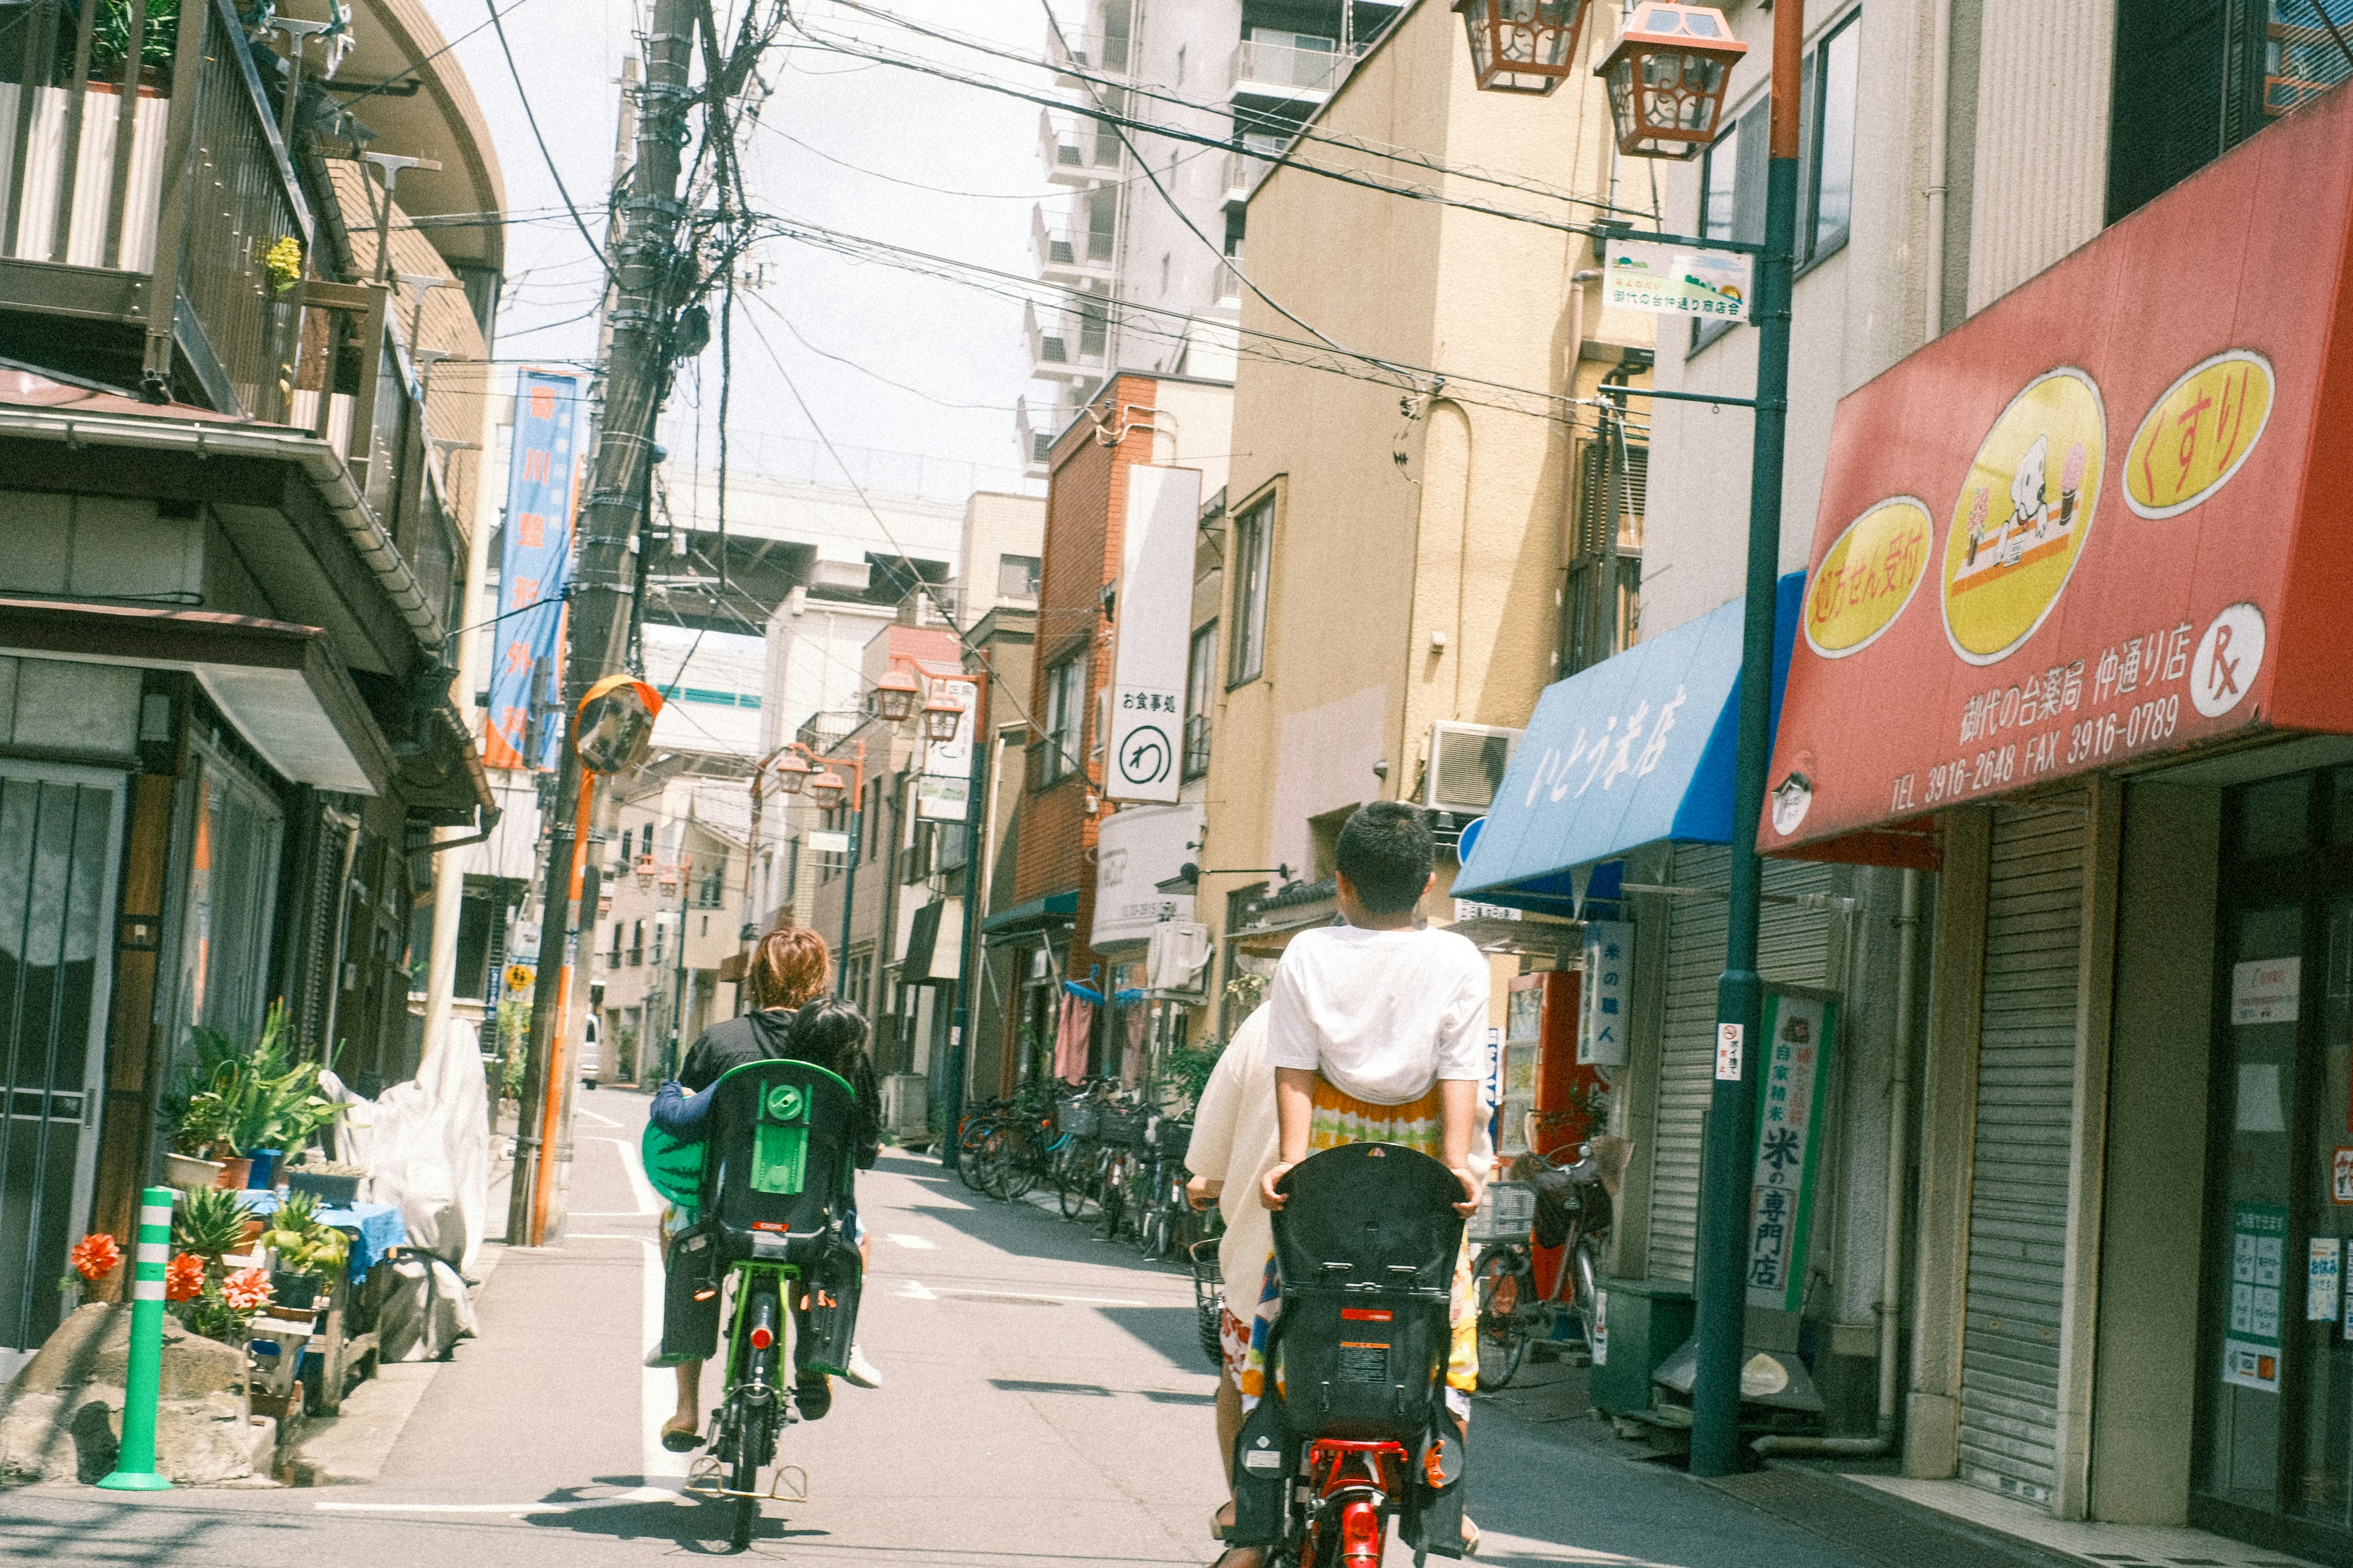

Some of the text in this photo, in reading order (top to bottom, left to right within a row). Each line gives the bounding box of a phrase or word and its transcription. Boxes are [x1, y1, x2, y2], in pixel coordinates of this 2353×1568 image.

[1613, 289, 1740, 316] 御代の台仲通り商店会
[2143, 365, 2249, 504] くすり
[1123, 692, 1176, 713] お食事処
[1959, 620, 2193, 746] 御代の台薬局 仲通り店
[1890, 694, 2180, 812] TEL 3916-2648 FAX 3916-0789
[1749, 1127, 1799, 1286] 米の専門店
